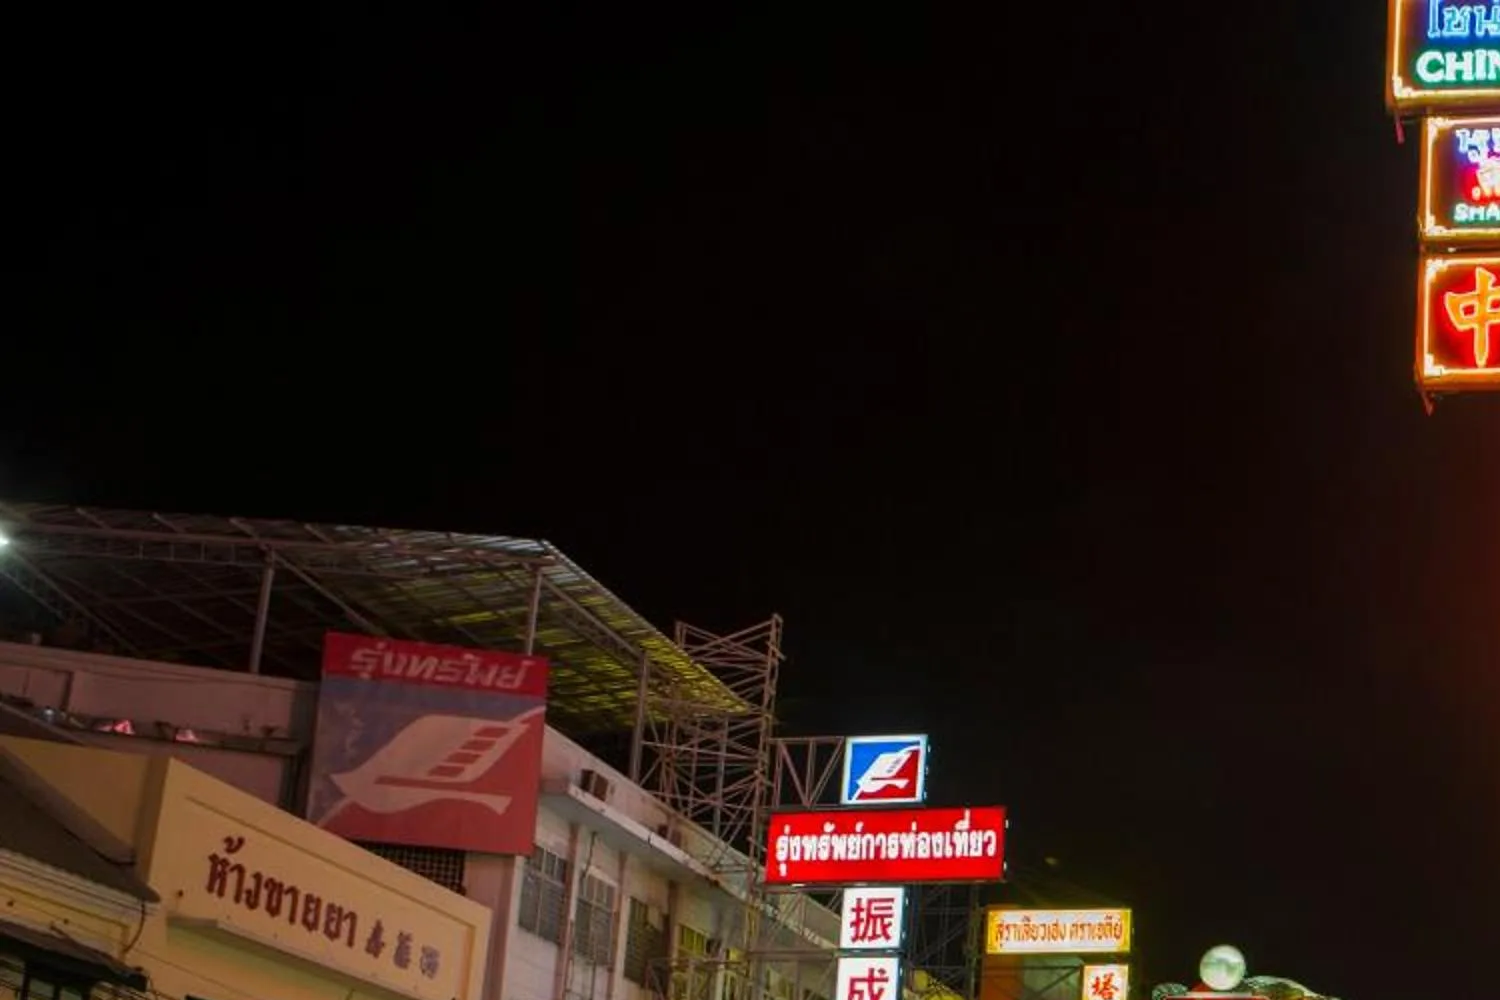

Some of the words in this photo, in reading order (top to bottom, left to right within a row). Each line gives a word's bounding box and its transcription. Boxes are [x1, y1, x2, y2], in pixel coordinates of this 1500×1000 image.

[776, 808, 996, 877] รุ่งทรัพย์การท่องเที่ยว
[206, 836, 358, 947] ห้างขายยา
